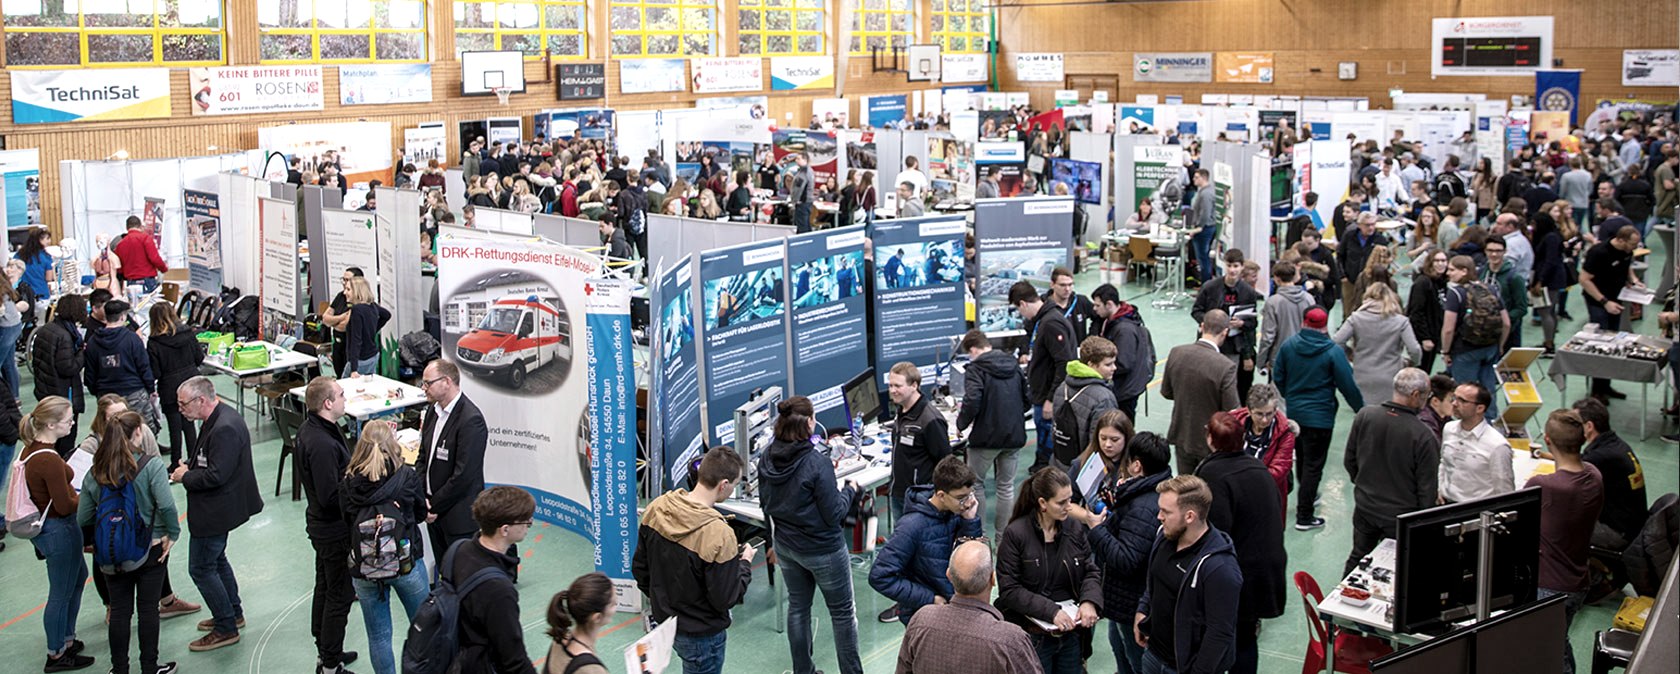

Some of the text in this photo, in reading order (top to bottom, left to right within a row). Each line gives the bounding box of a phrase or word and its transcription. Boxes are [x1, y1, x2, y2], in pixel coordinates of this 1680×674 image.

[218, 69, 319, 79] KEINE BITTERE PILLE
[46, 85, 140, 102] TechniSat
[255, 82, 306, 95] ROSEN
[219, 92, 241, 102] 601
[441, 247, 553, 265] DRK-Rettungsdienst
[612, 319, 626, 410] info@rd-emh.drk.de
[489, 426, 501, 434] ind
[501, 427, 513, 435] ein
[616, 412, 627, 444] E-Mail:
[602, 378, 615, 516] Leopoldstraße 34, 54550 Daun
[618, 460, 627, 468] 0
[618, 468, 627, 481] 82
[618, 482, 628, 495] 96
[619, 502, 628, 515] 92
[591, 470, 602, 566] DRK-Rettungsdienst
[620, 516, 629, 529] 65
[621, 538, 631, 574] Telefon:
